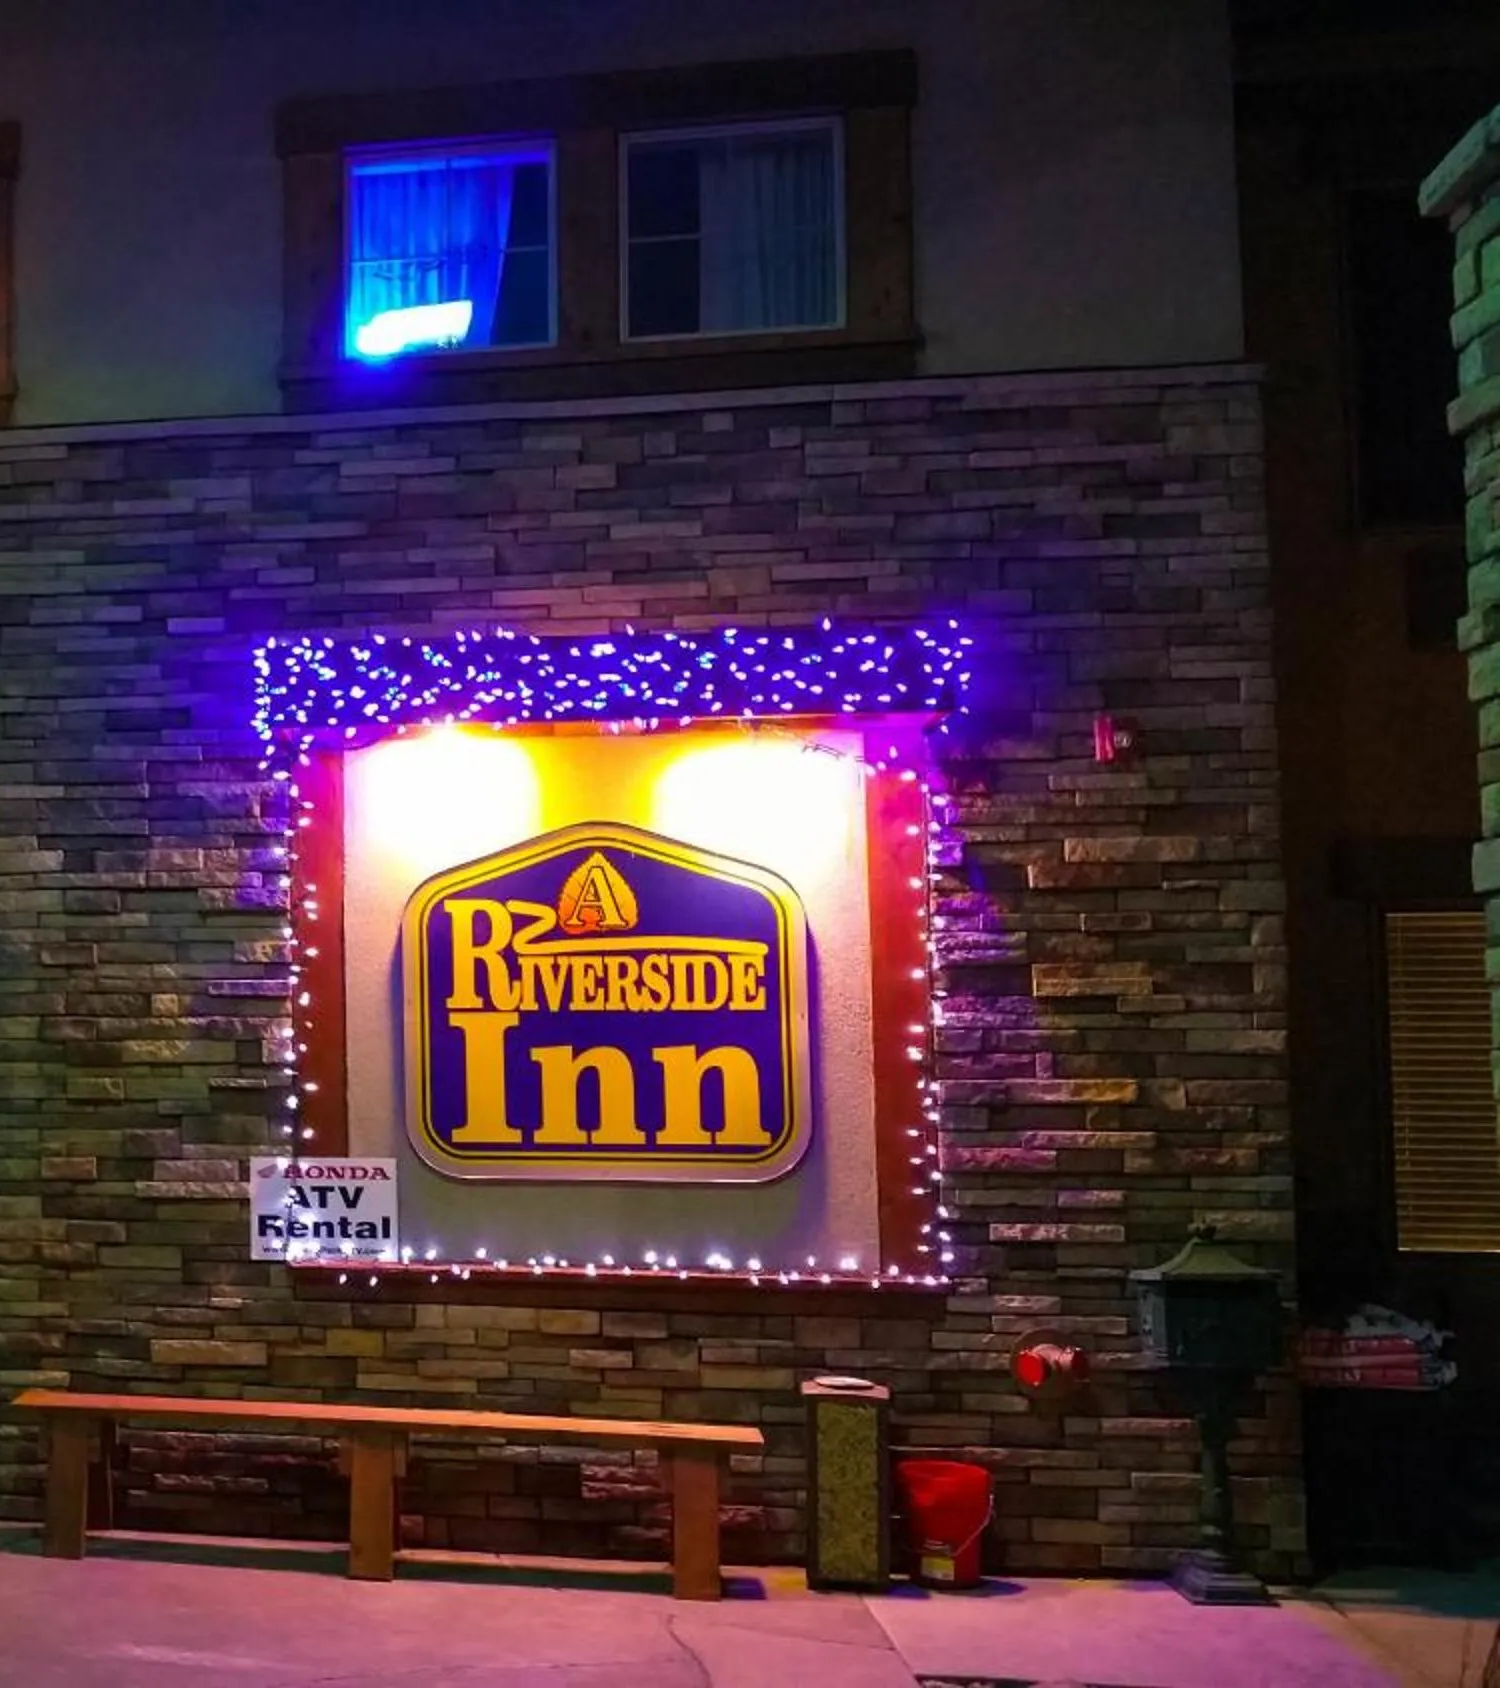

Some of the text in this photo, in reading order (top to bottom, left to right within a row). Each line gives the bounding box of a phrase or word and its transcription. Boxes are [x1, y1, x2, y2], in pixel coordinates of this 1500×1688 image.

[444, 899, 767, 1012] RIVERSIDE
[448, 1011, 772, 1145] Inn
[283, 1165, 391, 1181] HONDA
[286, 1185, 364, 1209] ATV
[258, 1214, 391, 1239] Rental
